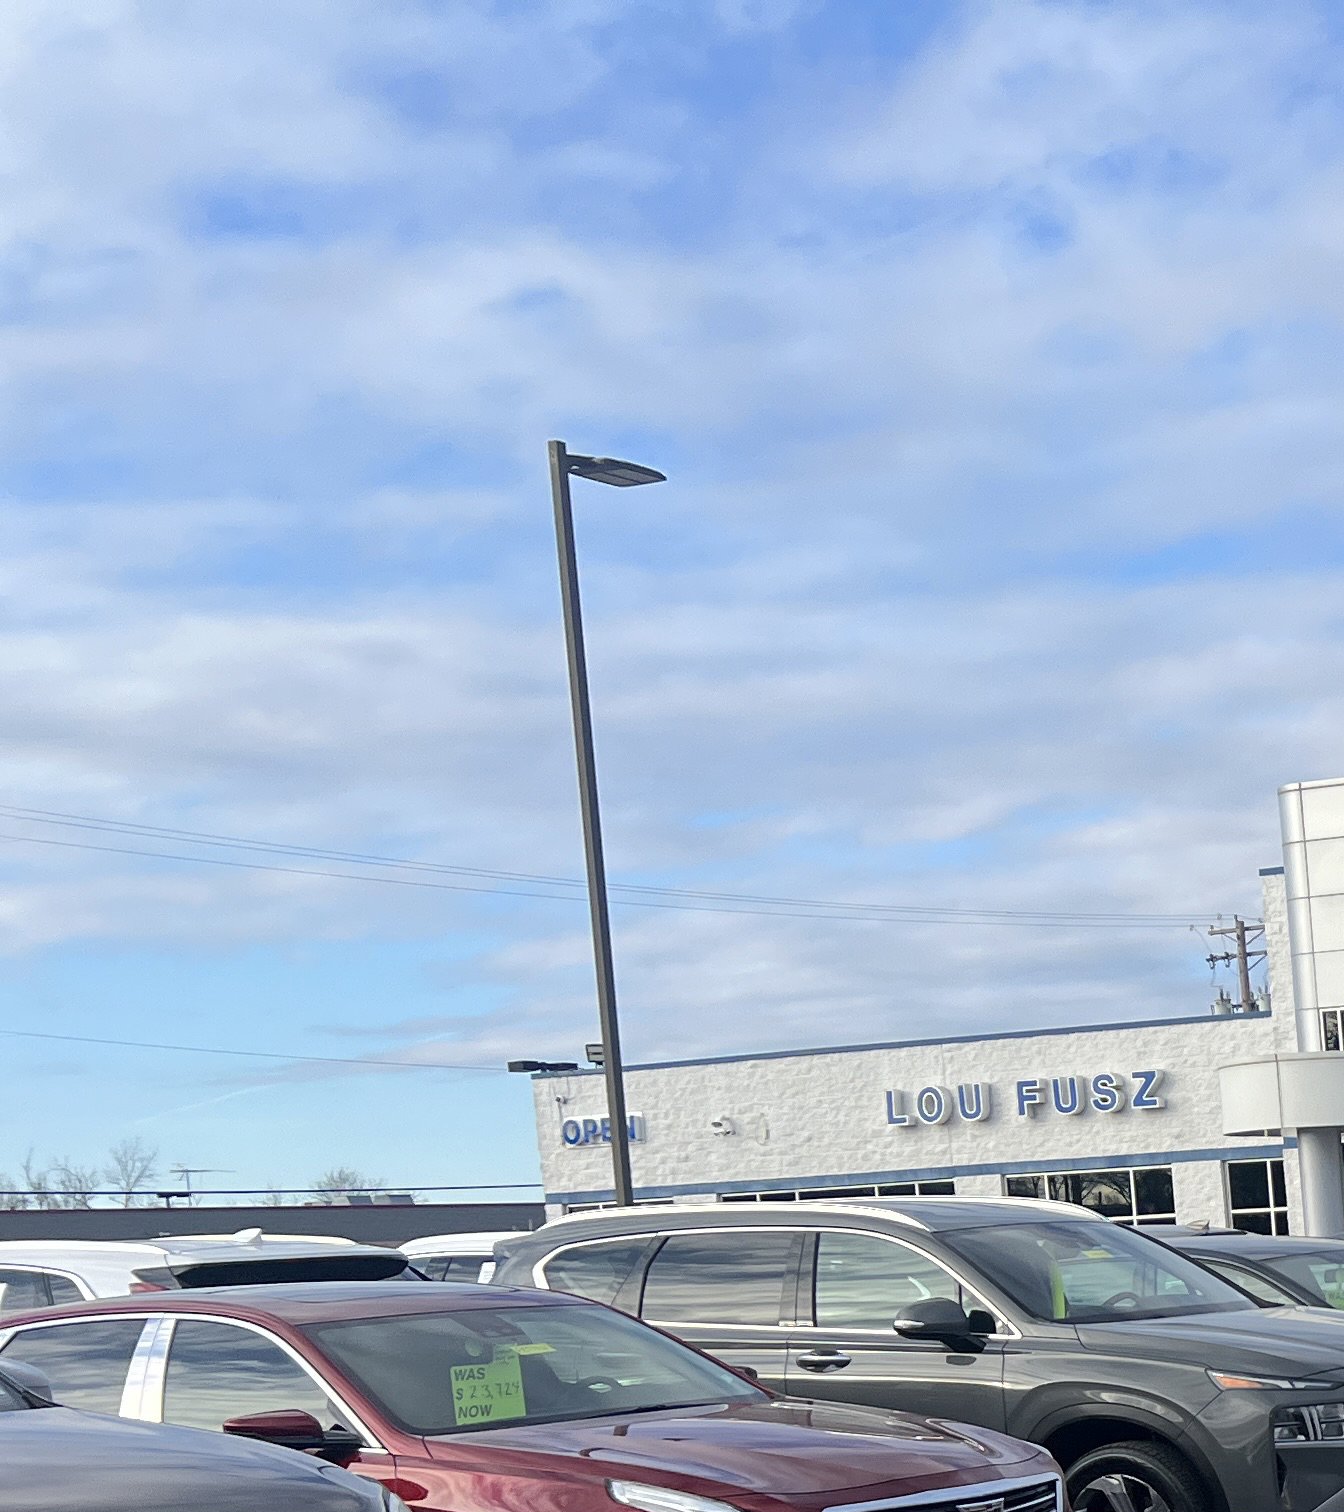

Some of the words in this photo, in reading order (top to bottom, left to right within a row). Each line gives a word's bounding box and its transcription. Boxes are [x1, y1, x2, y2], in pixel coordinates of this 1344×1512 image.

[885, 1082, 990, 1126] LOU
[1016, 1069, 1164, 1118] FUSZ
[453, 1367, 486, 1381] WAS
[457, 1404, 493, 1419] NOW
